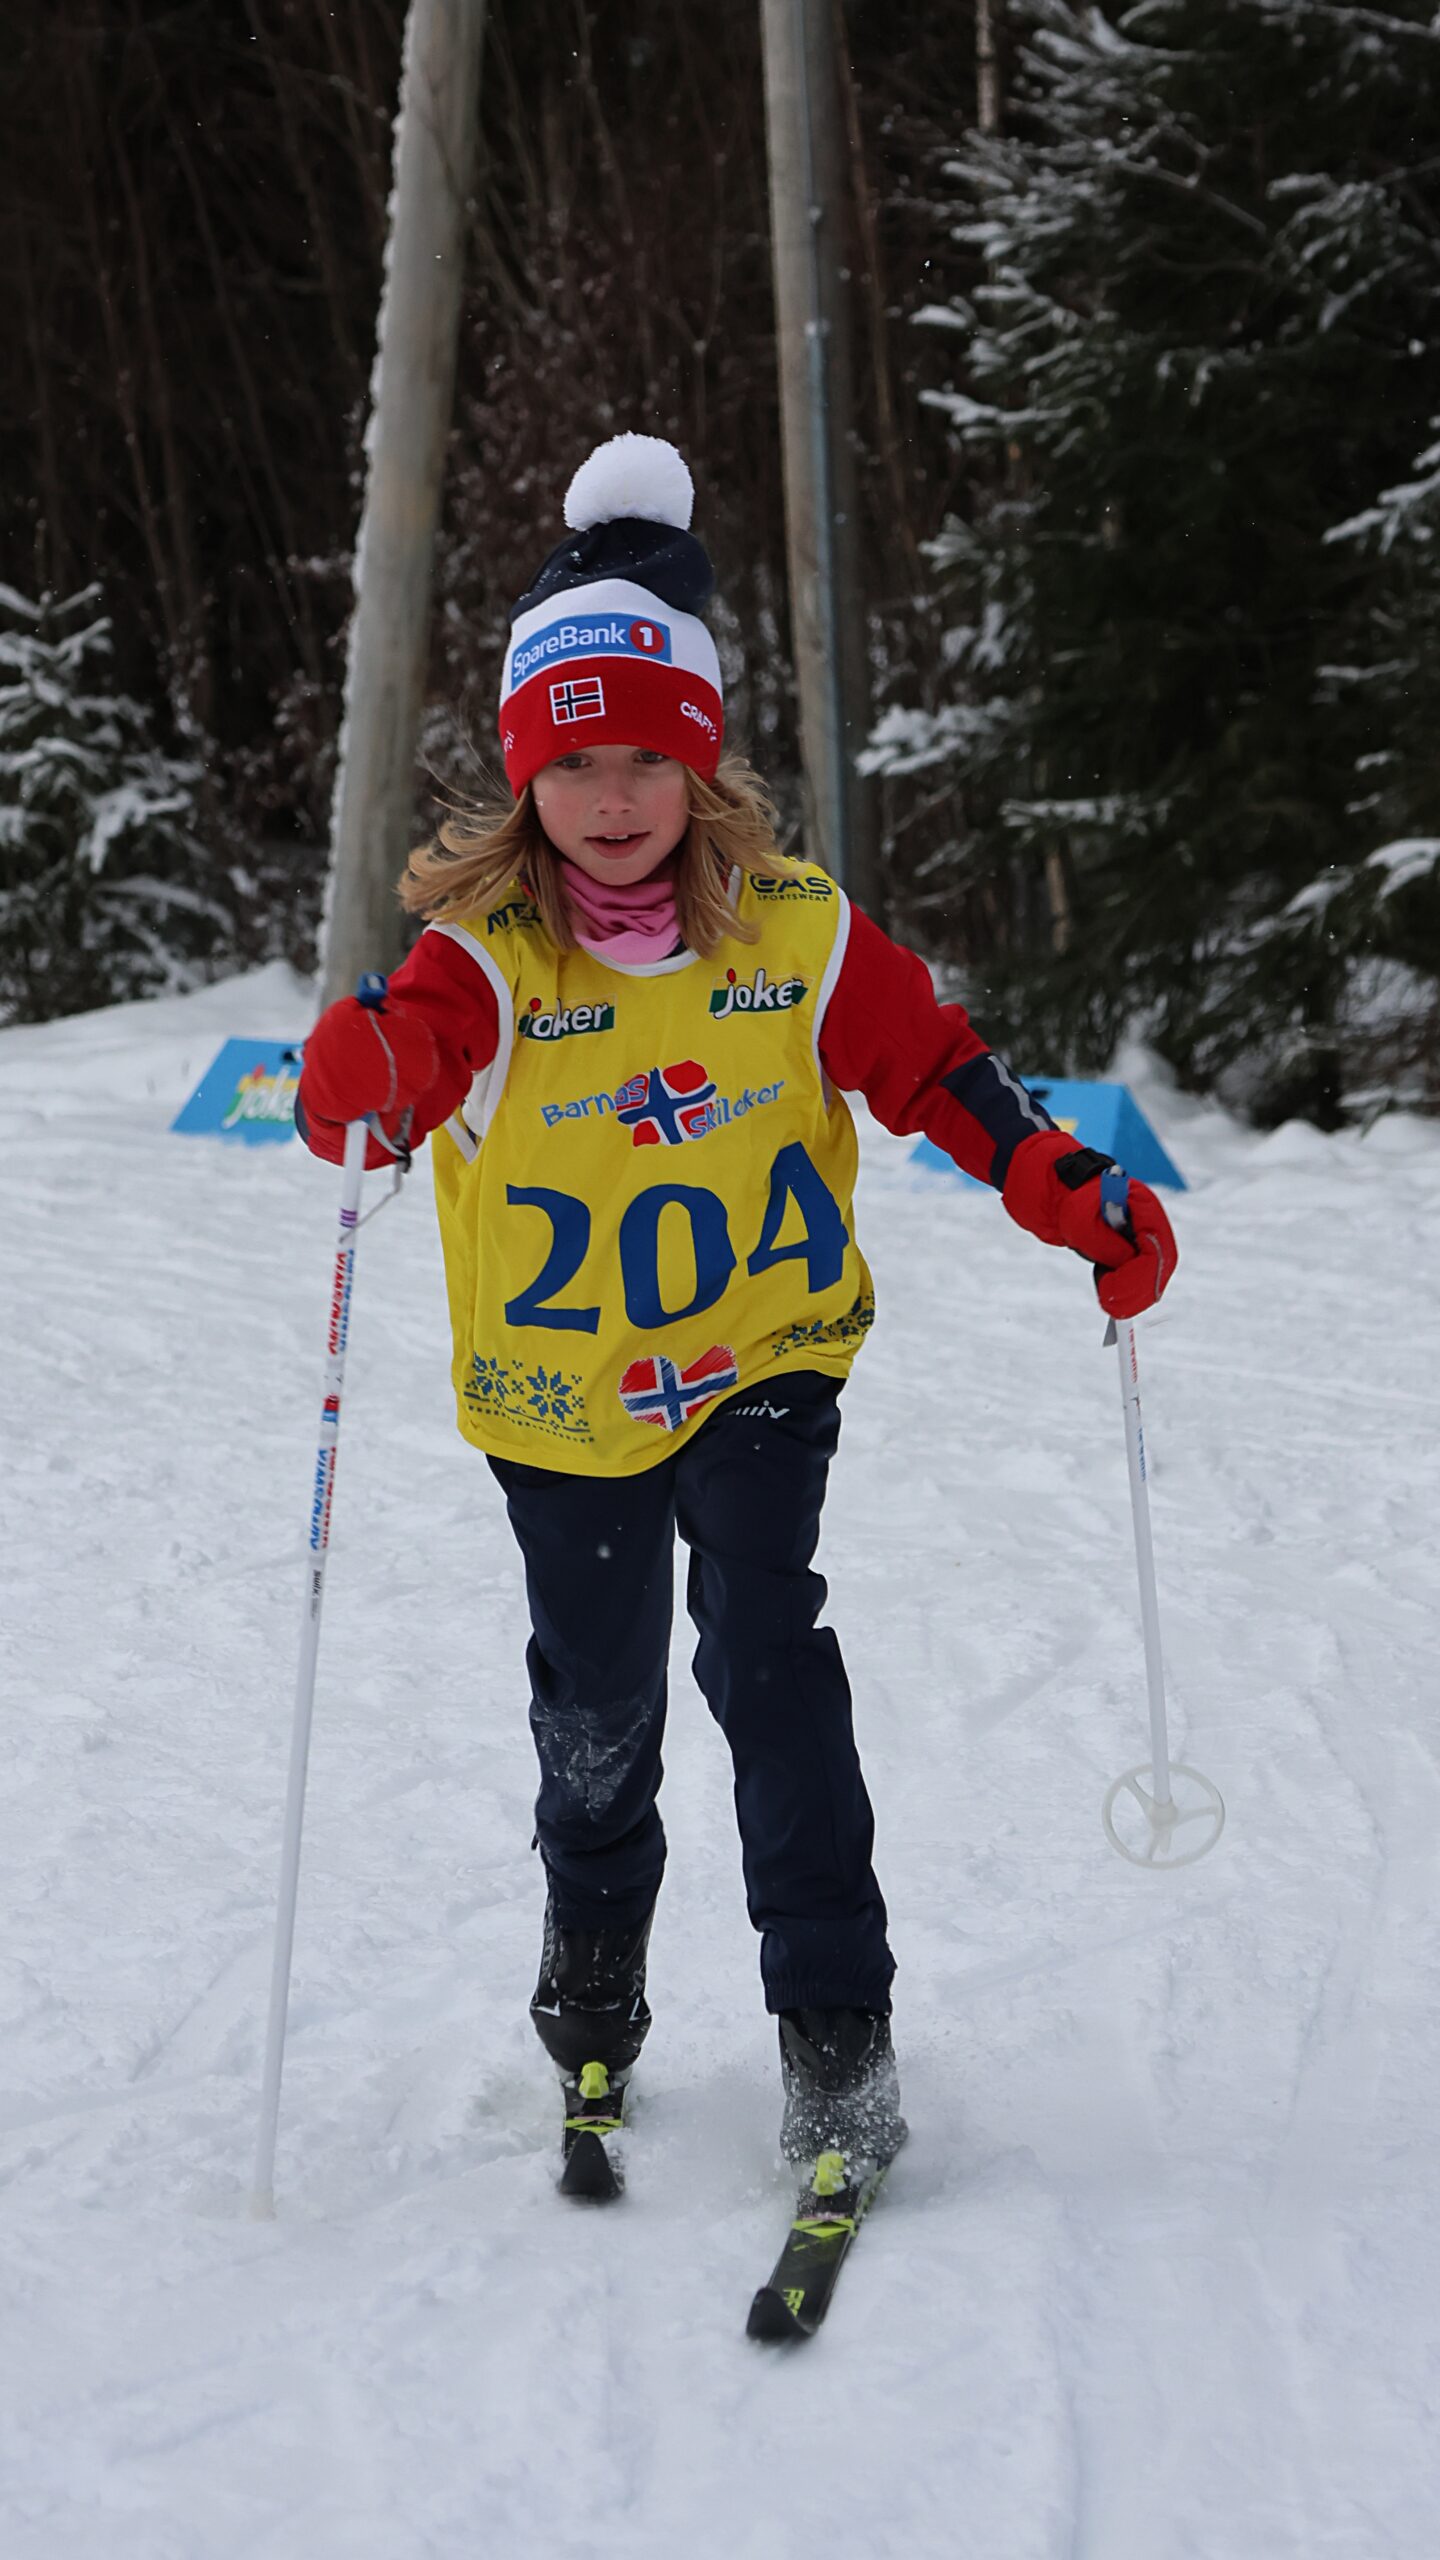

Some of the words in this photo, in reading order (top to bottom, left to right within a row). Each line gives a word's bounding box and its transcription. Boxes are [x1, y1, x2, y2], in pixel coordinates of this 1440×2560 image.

[513, 622, 627, 678] SpareBank
[639, 626, 653, 647] 1
[680, 701, 714, 734] CRAFT
[756, 893, 829, 903] SPORTSWEAR
[540, 1077, 646, 1129] Barnas
[504, 1140, 850, 1336] 204
